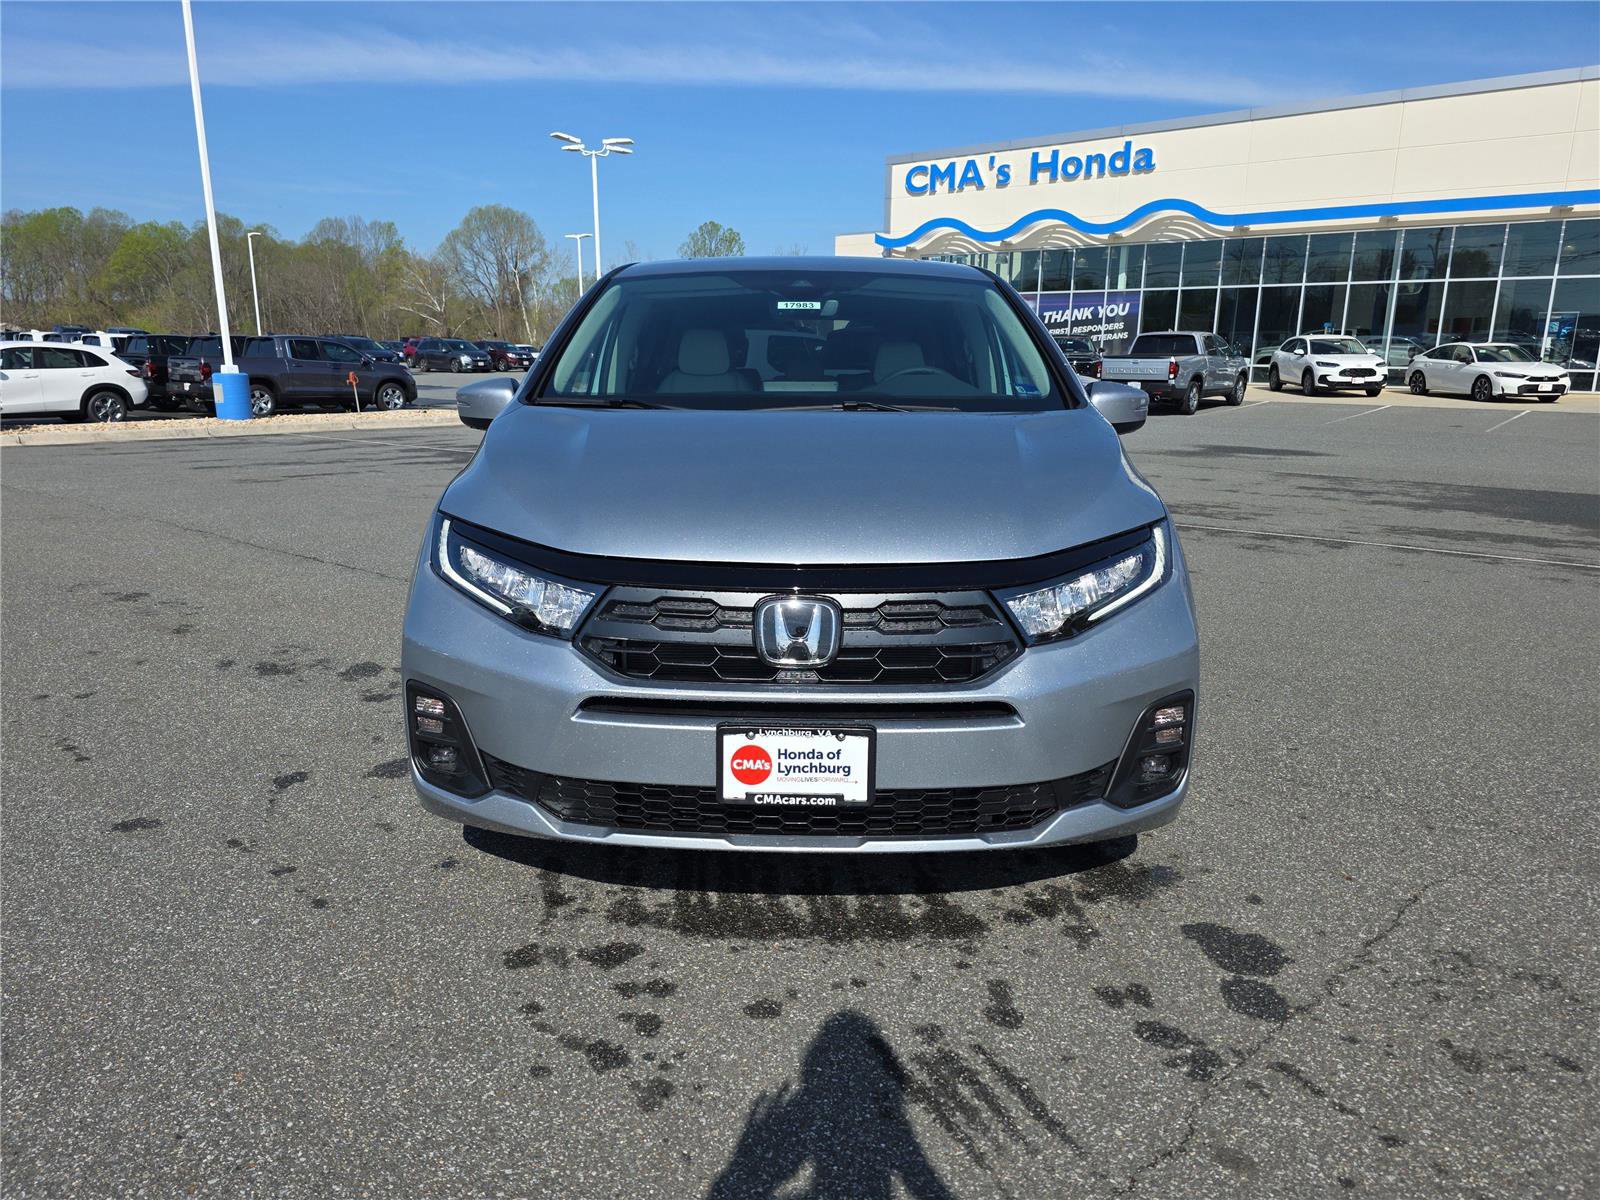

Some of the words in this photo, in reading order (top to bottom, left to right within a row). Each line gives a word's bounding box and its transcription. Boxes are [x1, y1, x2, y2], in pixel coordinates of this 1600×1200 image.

[905, 155, 1011, 195] CMA's
[1030, 140, 1156, 184] Honda
[1043, 306, 1094, 324] THANK
[1098, 302, 1130, 318] YOU
[1072, 322, 1124, 334] RESPONDERS
[777, 748, 824, 760] Honda
[826, 749, 842, 760] of
[732, 759, 770, 770] CMA's
[777, 762, 851, 777] Lynchburg
[754, 794, 837, 805] CMAcars.com
